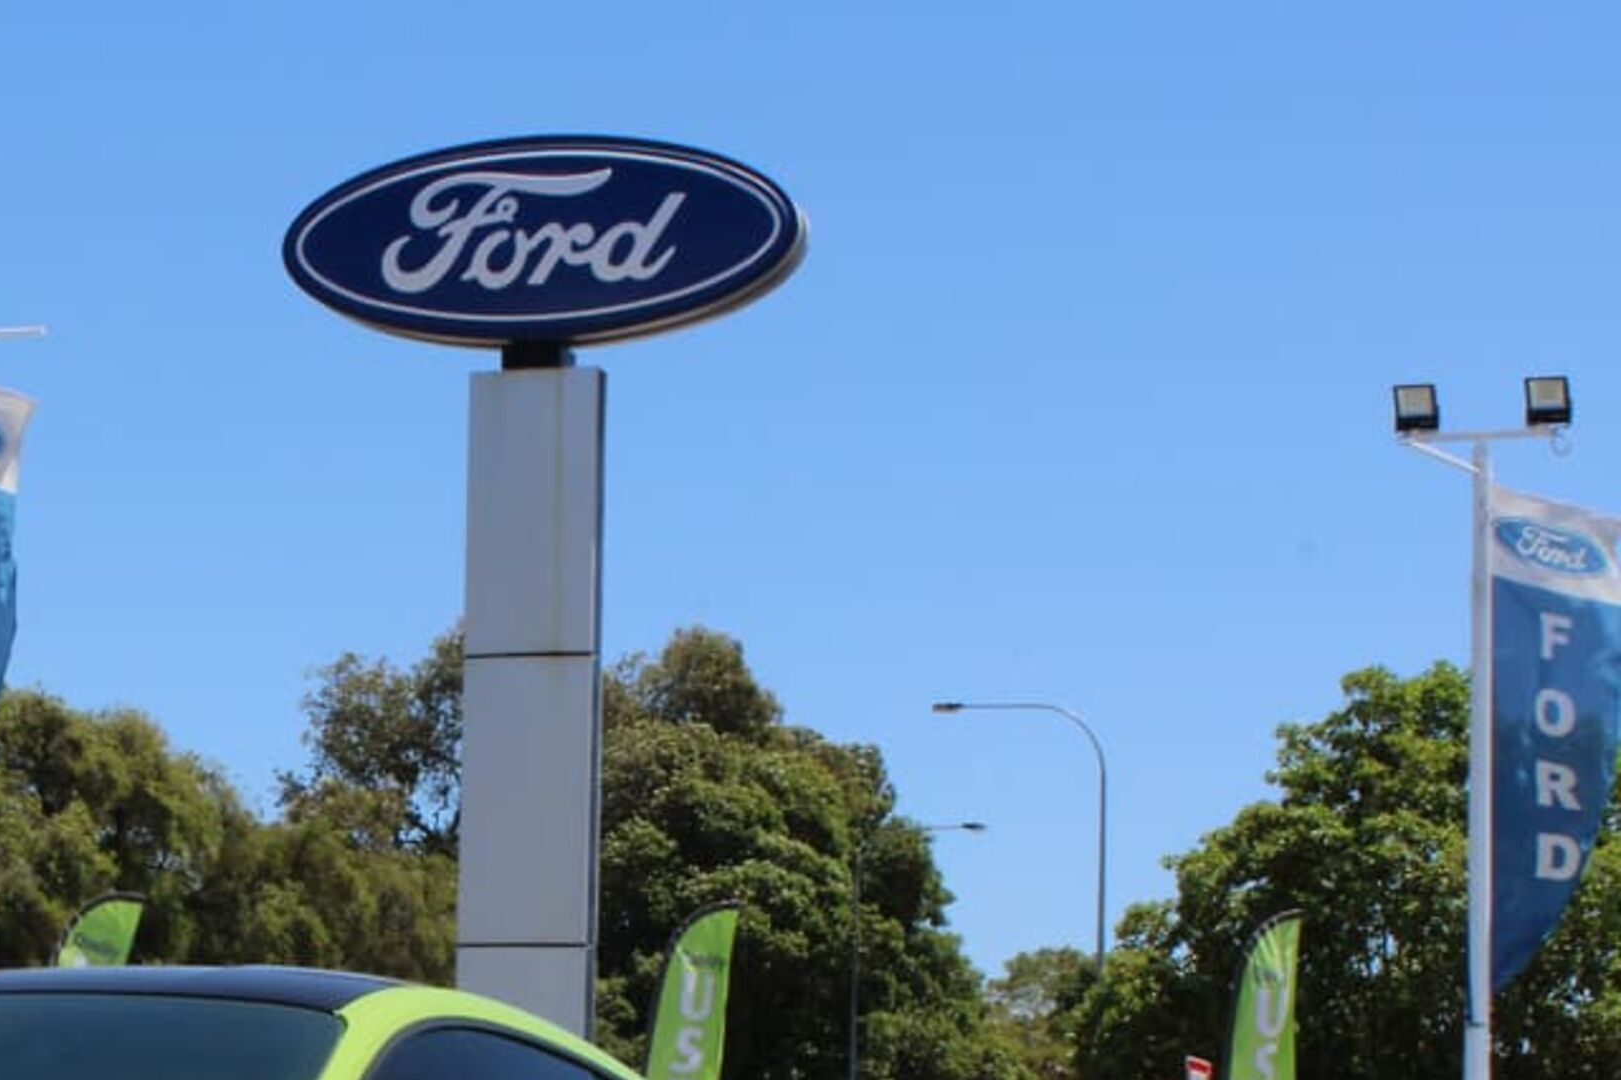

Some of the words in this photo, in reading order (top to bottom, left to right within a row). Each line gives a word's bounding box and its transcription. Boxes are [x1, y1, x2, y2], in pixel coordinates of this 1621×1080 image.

[381, 167, 686, 293] Ford
[1516, 526, 1588, 570] Ford
[1534, 611, 1582, 882] FORD
